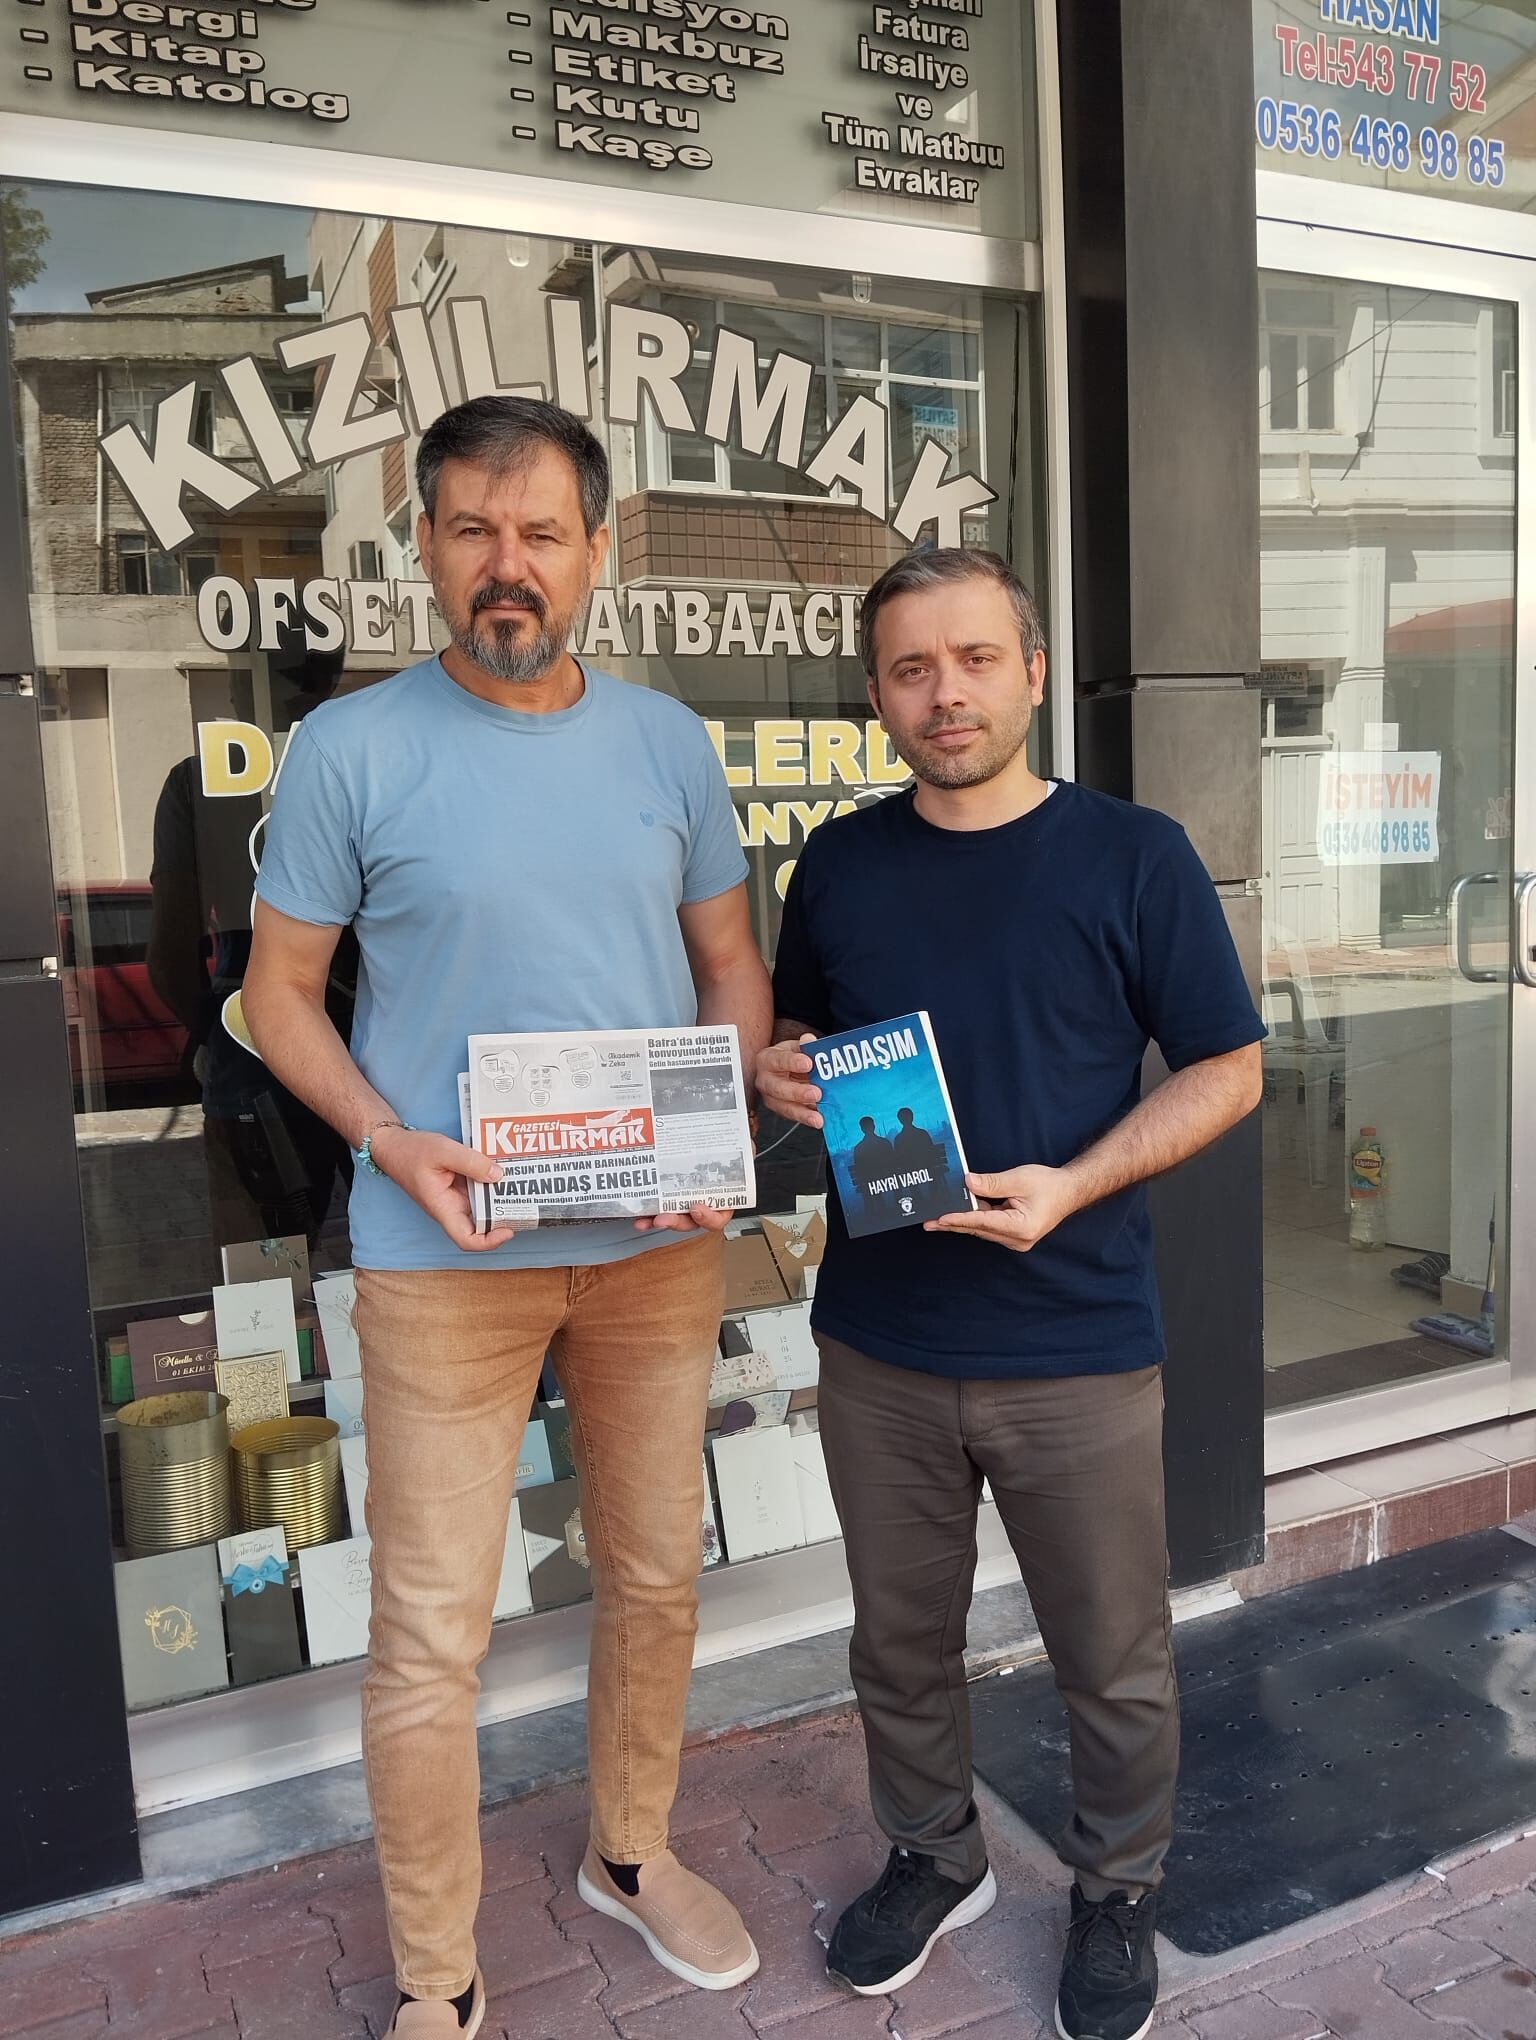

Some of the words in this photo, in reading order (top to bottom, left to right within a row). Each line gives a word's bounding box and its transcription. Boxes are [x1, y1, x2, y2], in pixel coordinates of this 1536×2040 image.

[69, 0, 258, 39] Dergi
[550, 9, 784, 75] Makbuz
[873, 7, 969, 51] Fatura
[71, 24, 265, 75] Kitap
[857, 36, 969, 89] İrsaliye
[1276, 24, 1395, 95] Tel:543
[1403, 51, 1440, 104] 77
[1449, 60, 1486, 113] 52
[75, 62, 350, 122] Katolog
[552, 46, 735, 103] Etiket
[554, 84, 700, 132] Kutu
[896, 92, 933, 121] ve
[555, 120, 713, 170] Kaşe
[822, 113, 890, 153] Tüm
[899, 125, 1005, 169] Matbuu
[1256, 96, 1341, 160] 0536
[1350, 115, 1411, 173] 468
[1420, 127, 1459, 180] 98
[1468, 135, 1504, 187] 85
[856, 158, 979, 203] Evraklar
[97, 295, 1000, 552] KIZILIRMAK
[198, 574, 435, 654] OFSET
[566, 587, 866, 657] ATBAACI
[1323, 821, 1360, 855] 0536
[1361, 821, 1389, 853] 468
[1392, 821, 1409, 853] 98
[1412, 820, 1430, 852] 85
[648, 1046, 707, 1058] konvoyunda
[709, 1045, 730, 1054] kaza
[695, 1035, 729, 1046] düğün
[815, 1028, 918, 1081] GADAŞIM
[485, 1122, 647, 1155] KIZILIRMAK
[512, 1120, 561, 1133] GAZETESİ
[493, 1174, 591, 1196] VATANDAŞ
[554, 1161, 592, 1172] HAYVAN
[594, 1154, 656, 1169] BARINAĞINA
[868, 1174, 899, 1195] HAYRİ
[899, 1168, 933, 1188] VAROL
[1357, 1160, 1379, 1168] Lipton
[662, 1200, 677, 1211] ölü
[727, 1195, 747, 1208] çıktı
